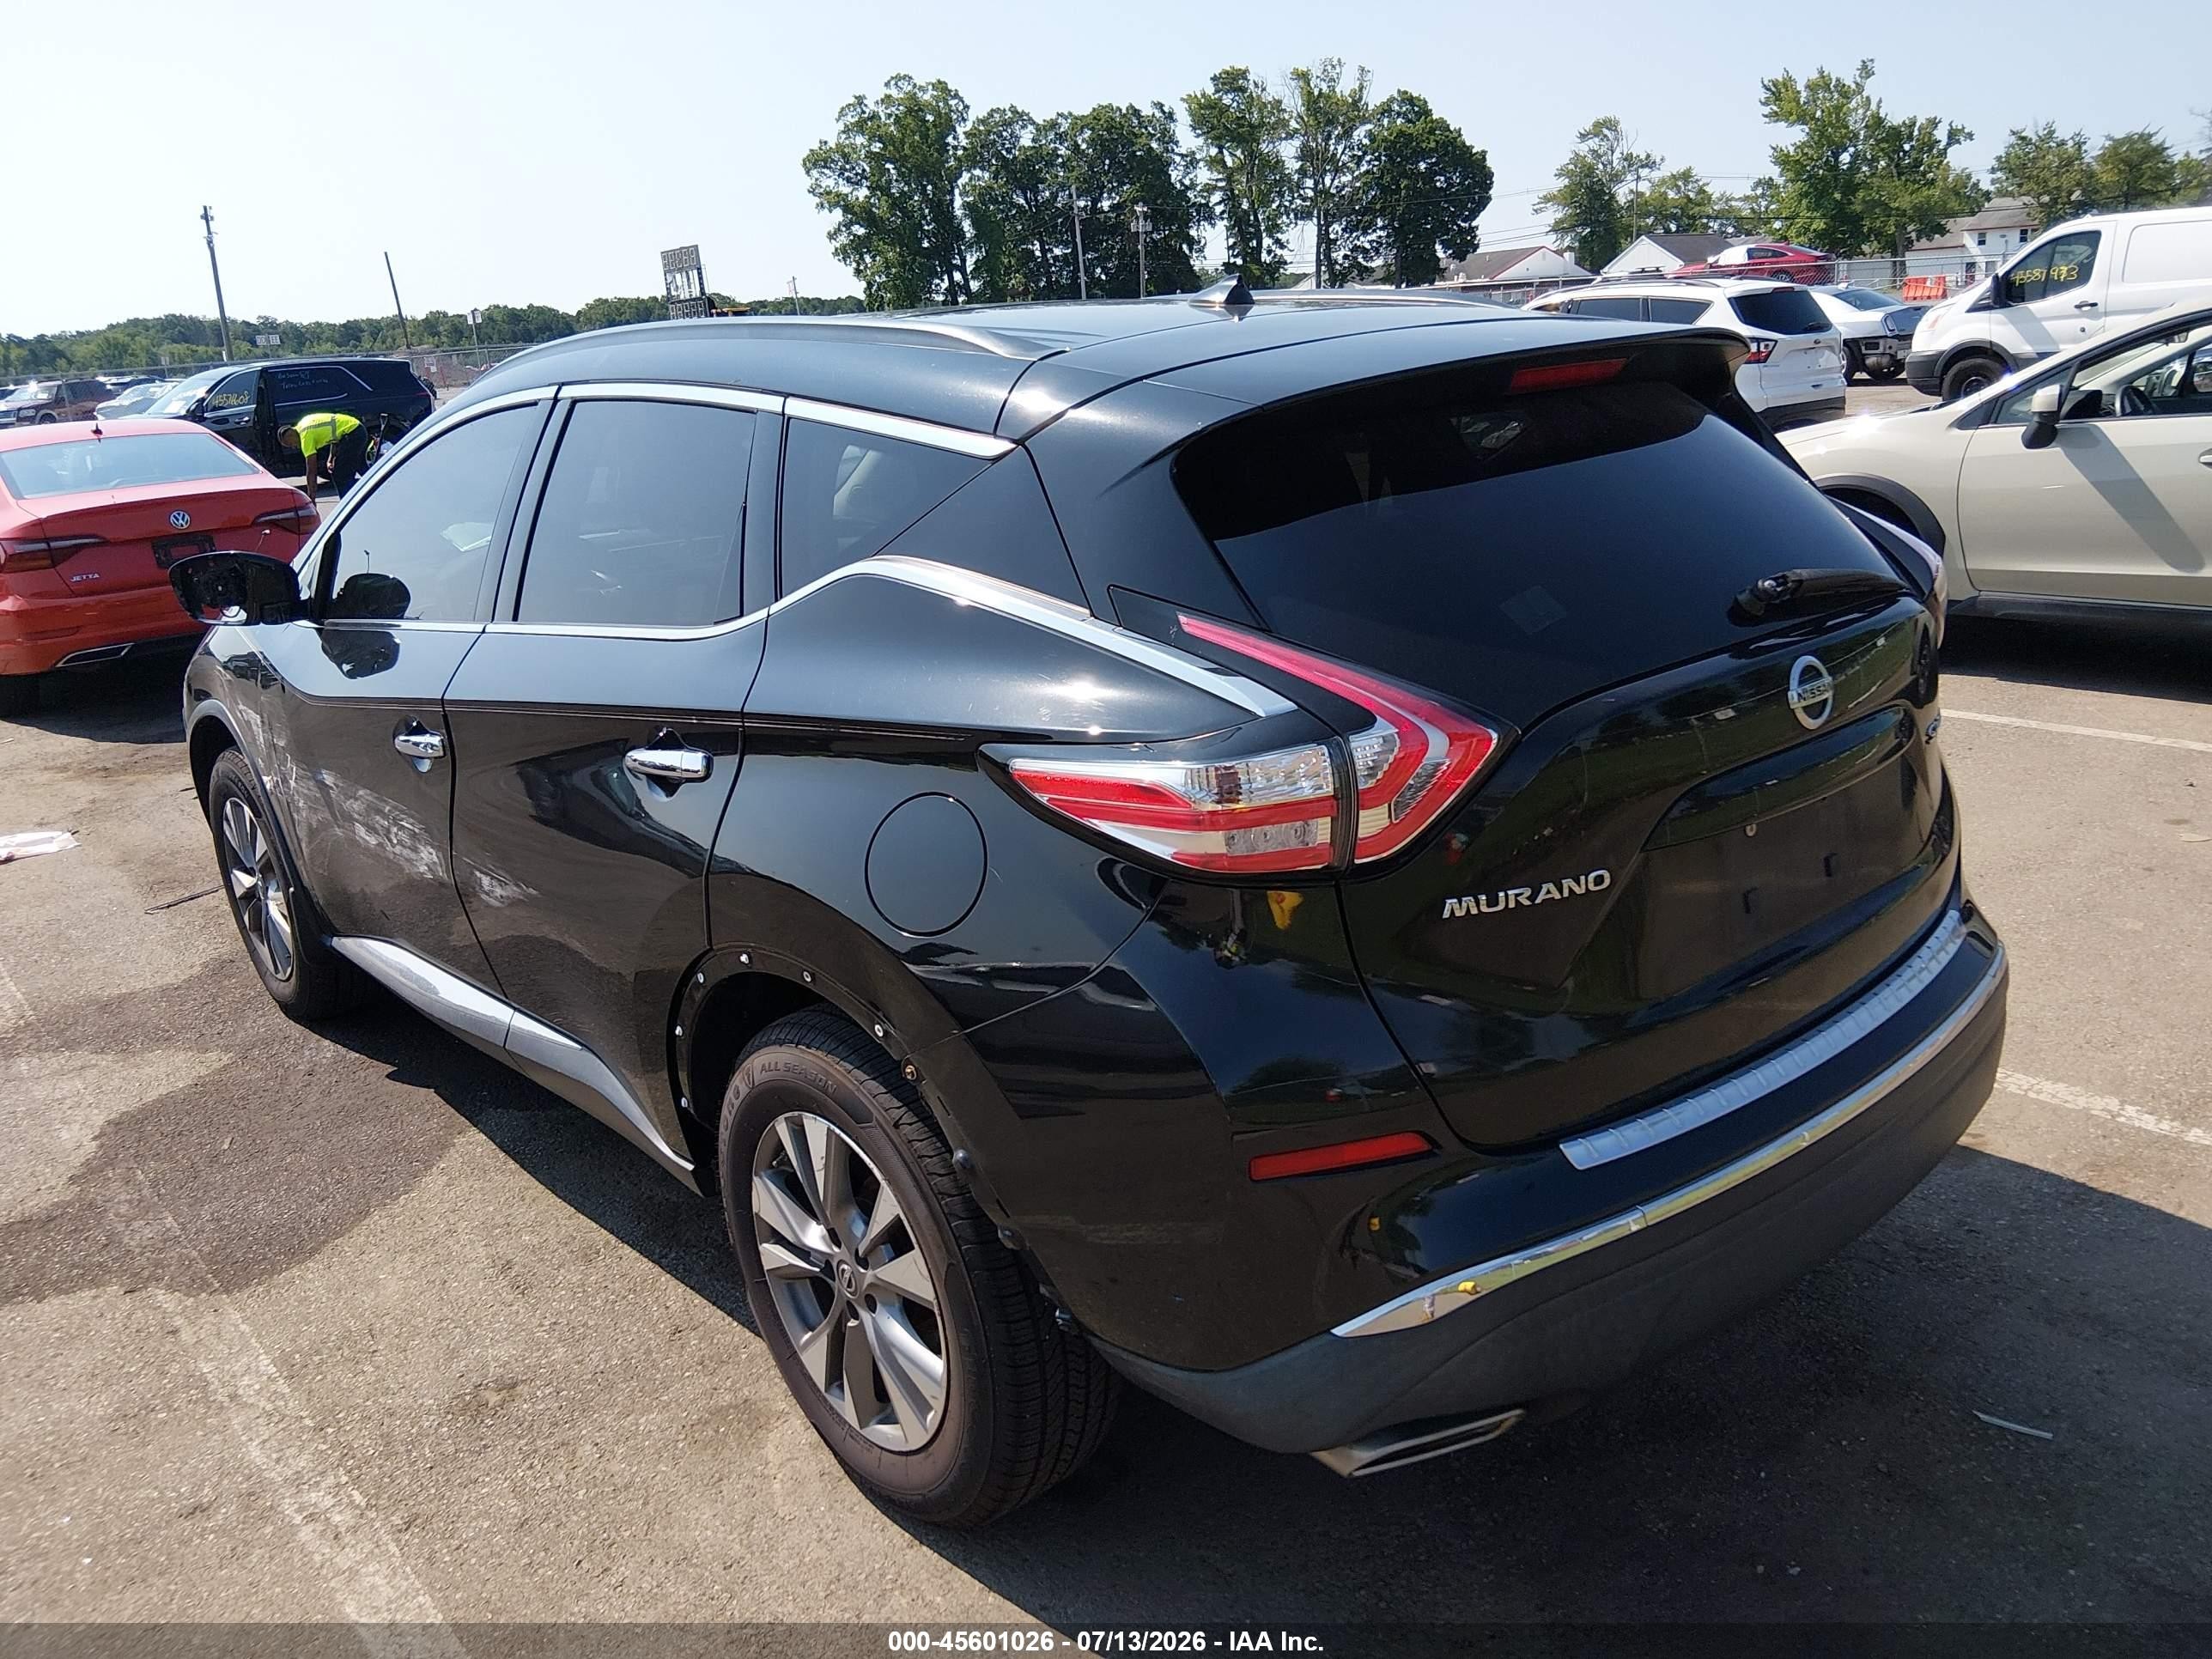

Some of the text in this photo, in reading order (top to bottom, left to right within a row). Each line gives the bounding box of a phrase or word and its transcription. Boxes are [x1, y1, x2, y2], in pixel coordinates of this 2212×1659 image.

[70, 572, 100, 583] JETTA
[1442, 869, 1612, 919] MURANO
[760, 1061, 838, 1097] ALL SEASON
